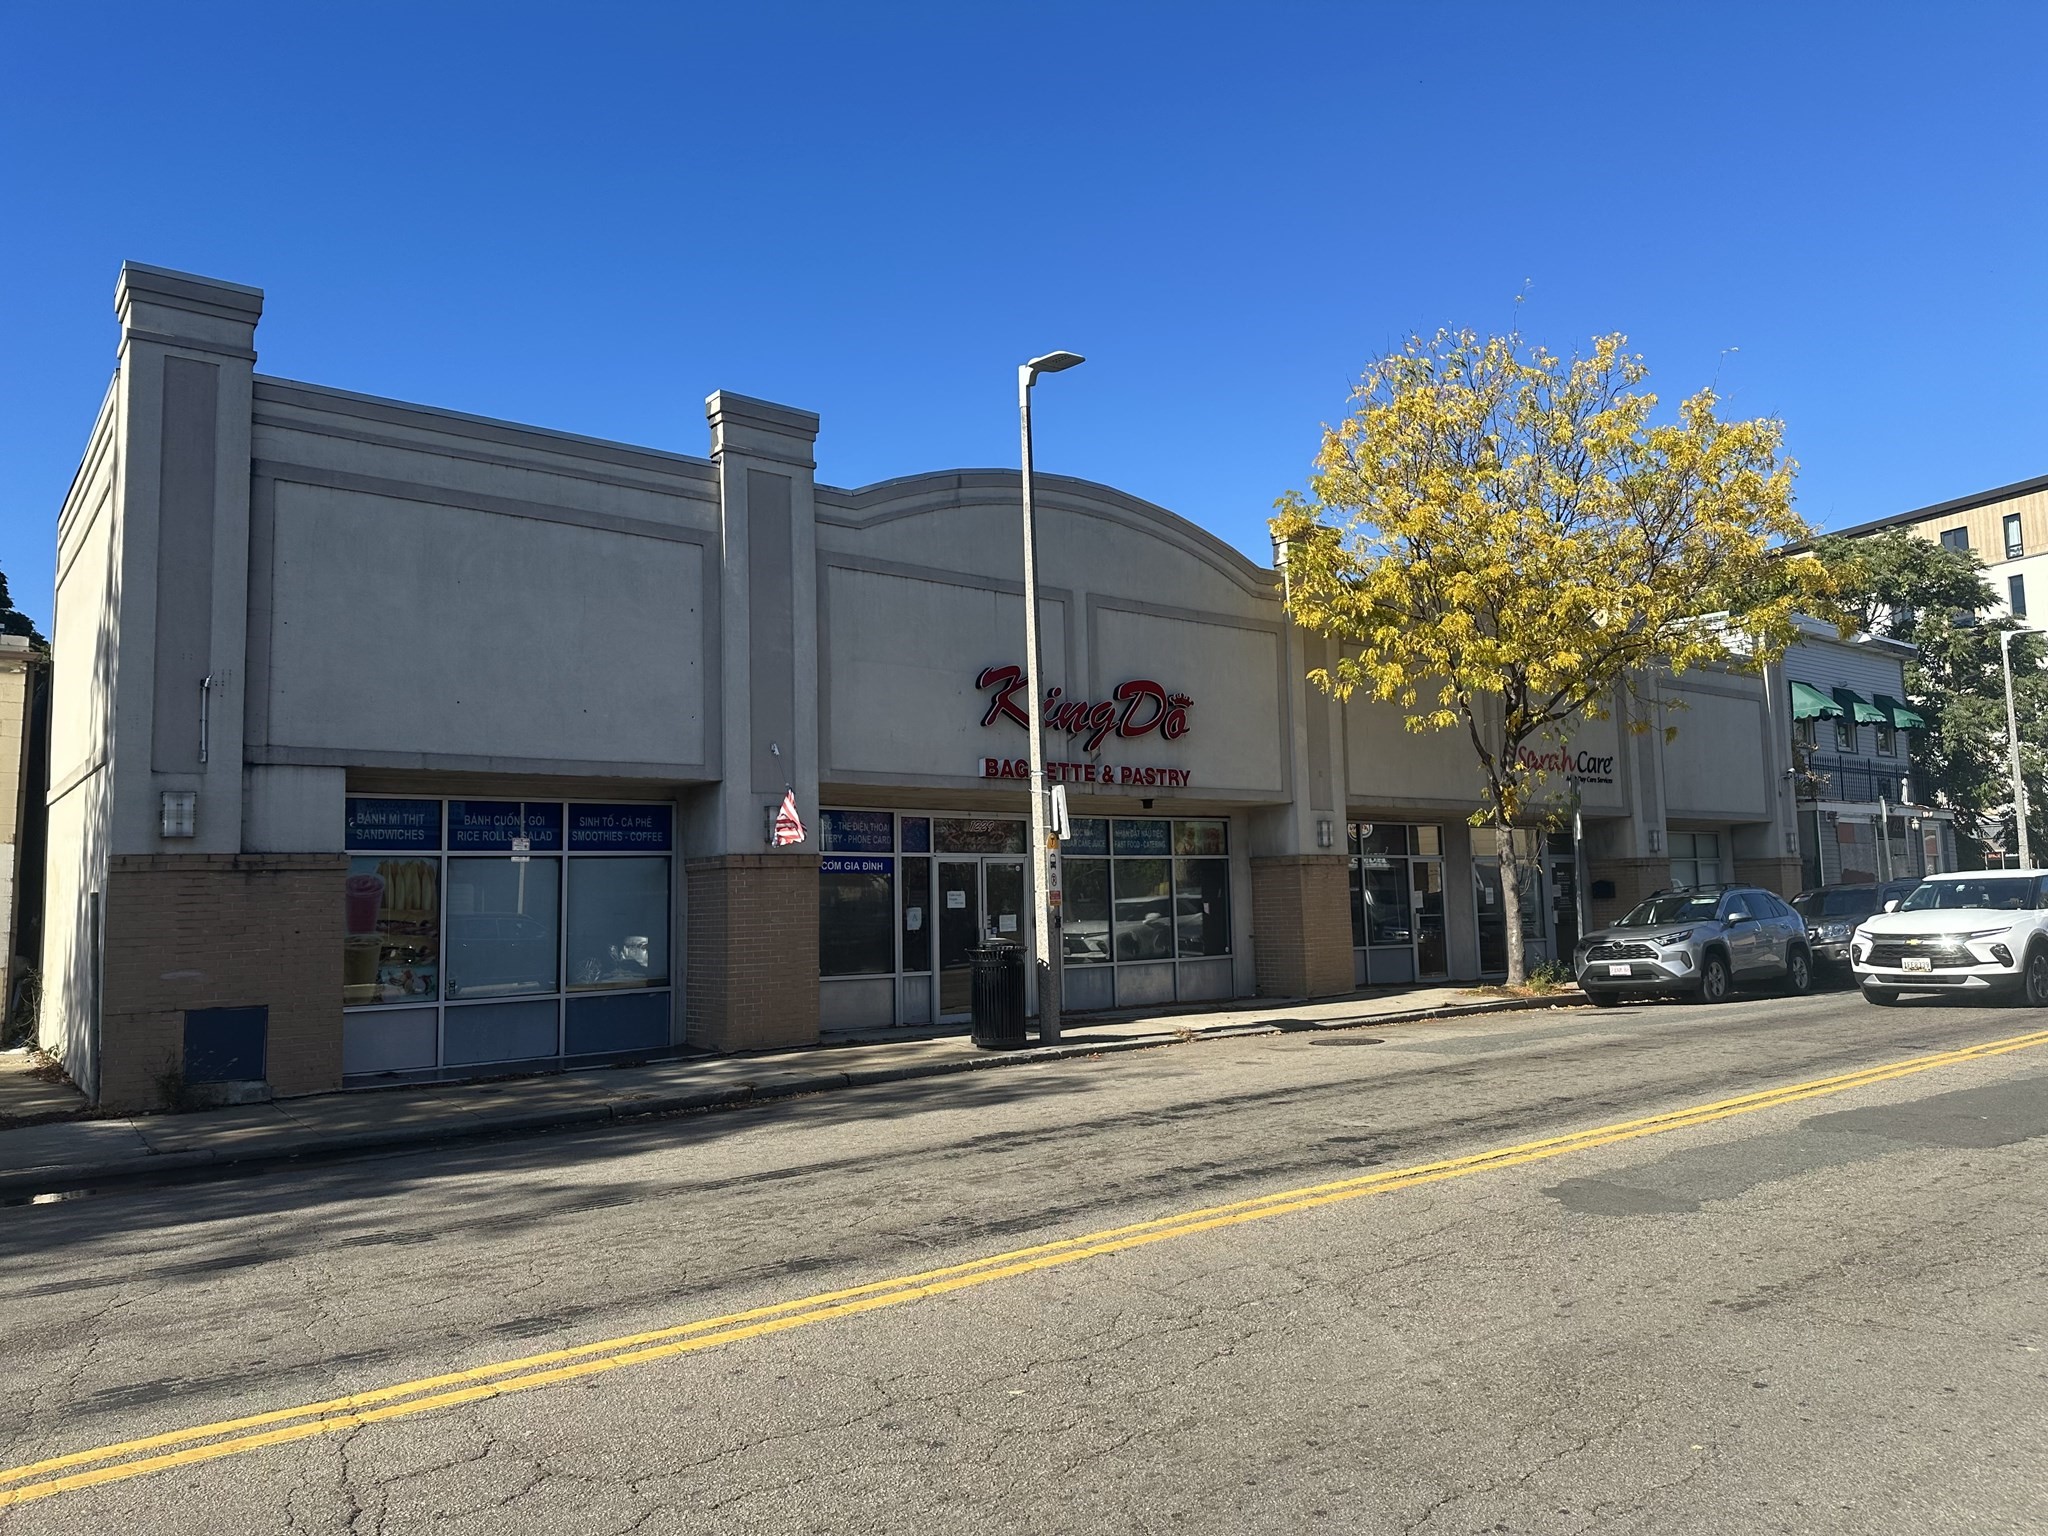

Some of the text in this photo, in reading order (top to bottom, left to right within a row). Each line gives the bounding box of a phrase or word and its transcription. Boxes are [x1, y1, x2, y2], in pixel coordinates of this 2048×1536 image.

[984, 758, 1191, 787] BAGETTE & PASTRY
[402, 813, 425, 827] THỊT
[493, 811, 520, 826] CUỐN
[579, 816, 600, 827] SINH
[602, 813, 614, 827] TỐ
[356, 829, 425, 841] SANDWICHES
[457, 830, 553, 842] RICE ROLLS SALAD
[571, 830, 623, 841] SMOOTHIES
[629, 831, 664, 842] COFFEE
[847, 834, 871, 844] PHONE
[872, 835, 891, 845] CARD
[1127, 840, 1140, 849] FOOD
[1143, 840, 1167, 849] CATERING
[844, 861, 860, 871] GIA
[862, 860, 884, 871] ĐÌNH
